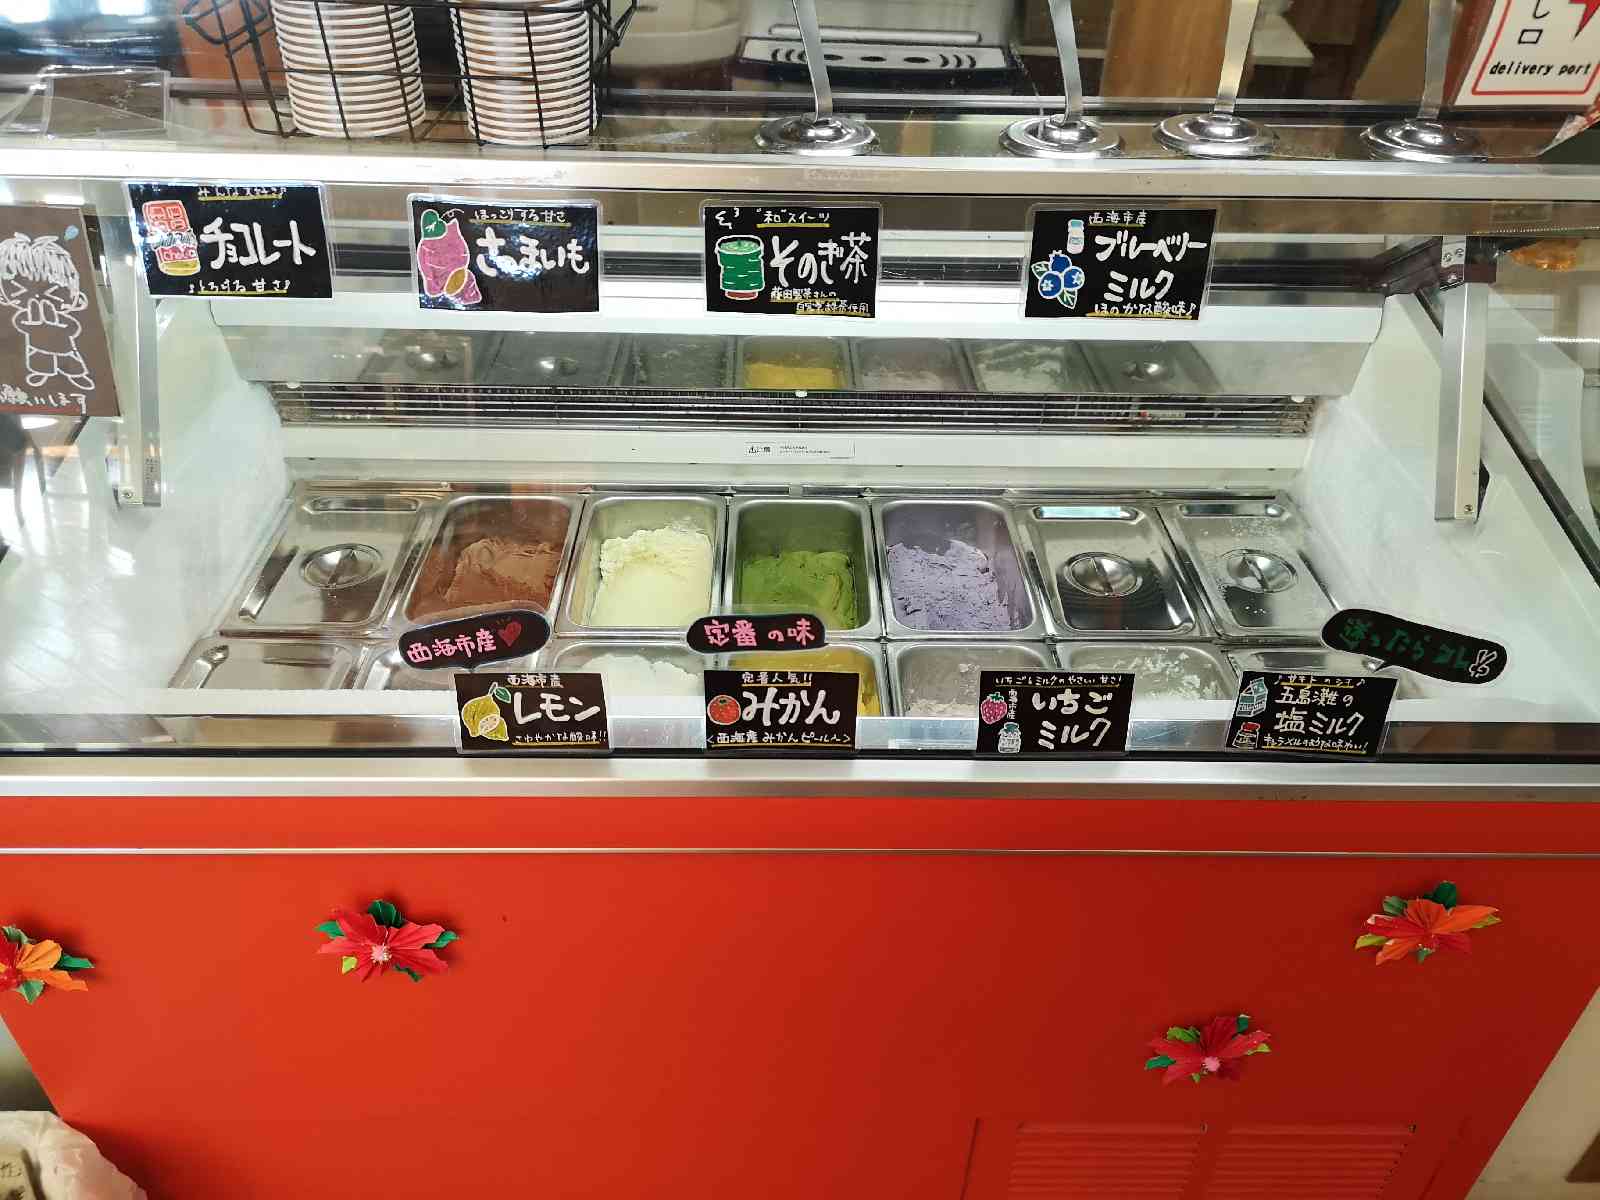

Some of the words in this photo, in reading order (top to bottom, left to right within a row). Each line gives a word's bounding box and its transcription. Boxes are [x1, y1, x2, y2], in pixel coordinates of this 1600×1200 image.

[1489, 61, 1552, 76] delivery
[1558, 63, 1592, 76] port
[475, 209, 567, 222] ほっこりする甘さ
[1088, 211, 1148, 225] 西海市産
[200, 216, 316, 269] チョコレート
[1094, 230, 1207, 262] ブルーベリー
[770, 232, 872, 287] そのぎ茶
[1103, 269, 1175, 302] ミルク
[406, 628, 496, 662] 西海市産
[704, 618, 815, 646] 定番の味
[513, 691, 600, 725] レモン
[741, 687, 840, 726] みかん
[1032, 688, 1113, 715] いちご
[1274, 686, 1354, 708] 五島灘の
[1037, 717, 1111, 750] ミルク
[1273, 707, 1365, 736] 塩ミルク
